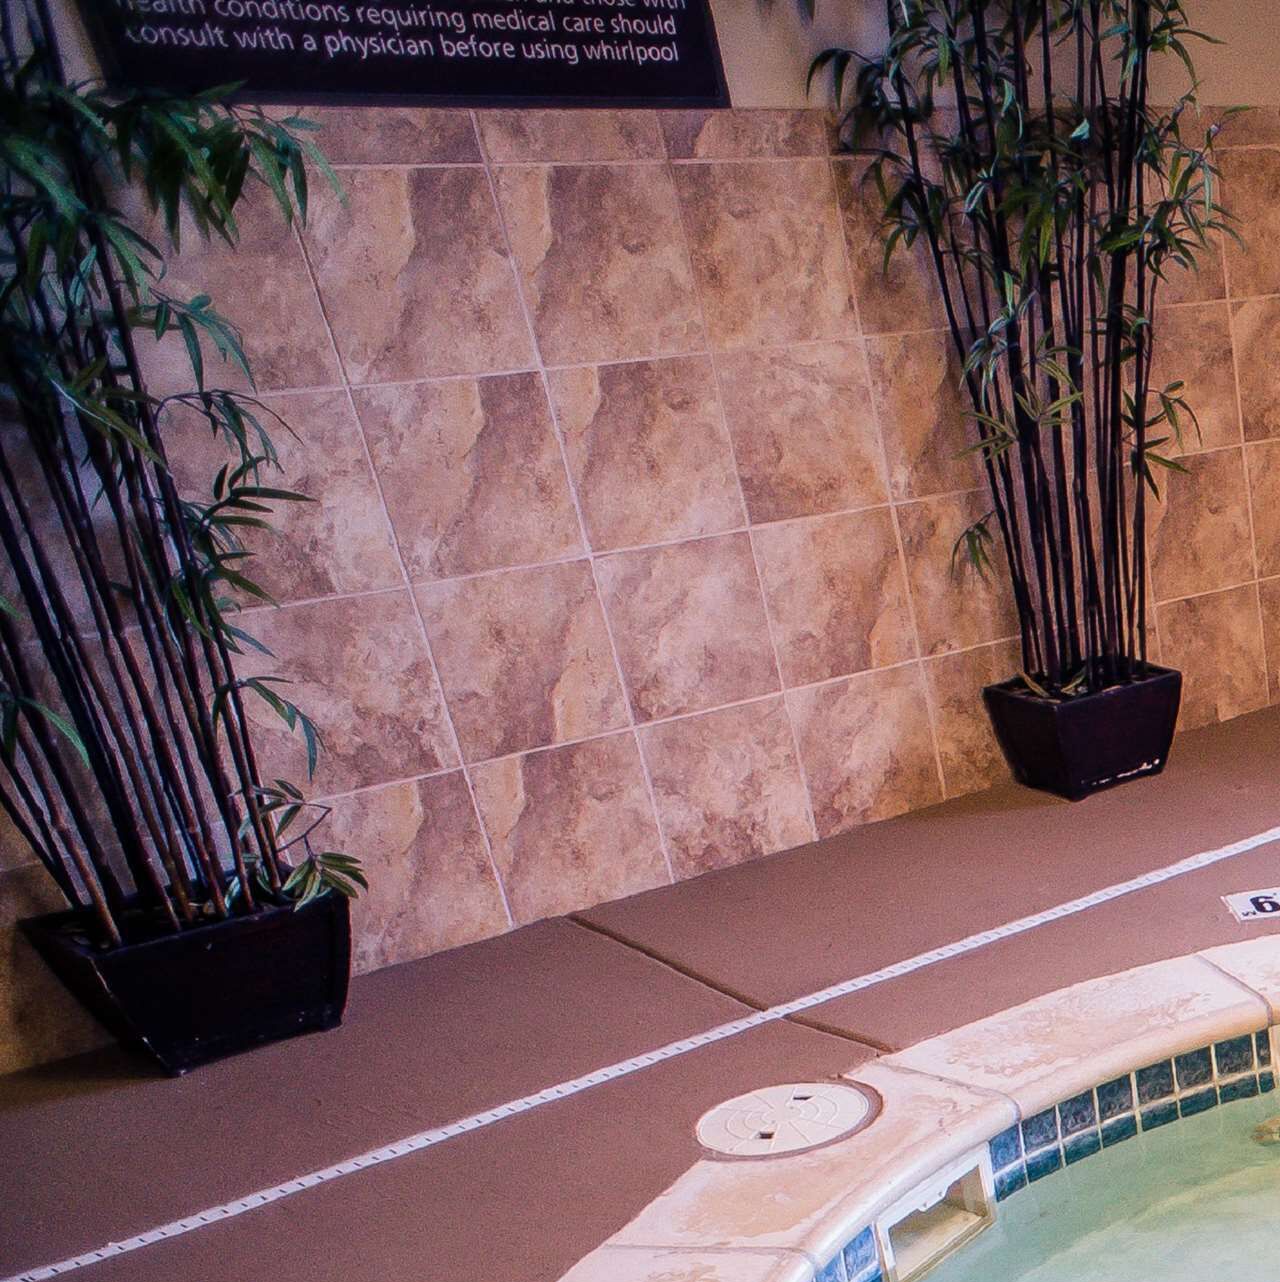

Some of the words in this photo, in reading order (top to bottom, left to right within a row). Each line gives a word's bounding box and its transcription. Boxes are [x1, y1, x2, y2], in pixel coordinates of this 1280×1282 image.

[214, 0, 350, 23] conditions
[355, 3, 466, 33] requiring
[472, 8, 556, 31] medical
[562, 16, 605, 33] care
[610, 13, 676, 35] should
[126, 22, 229, 48] consult
[233, 25, 294, 50] with
[302, 34, 317, 51] a
[324, 29, 434, 59] physician
[440, 33, 516, 58] before
[521, 38, 579, 65] using
[582, 40, 679, 65] whirlpool
